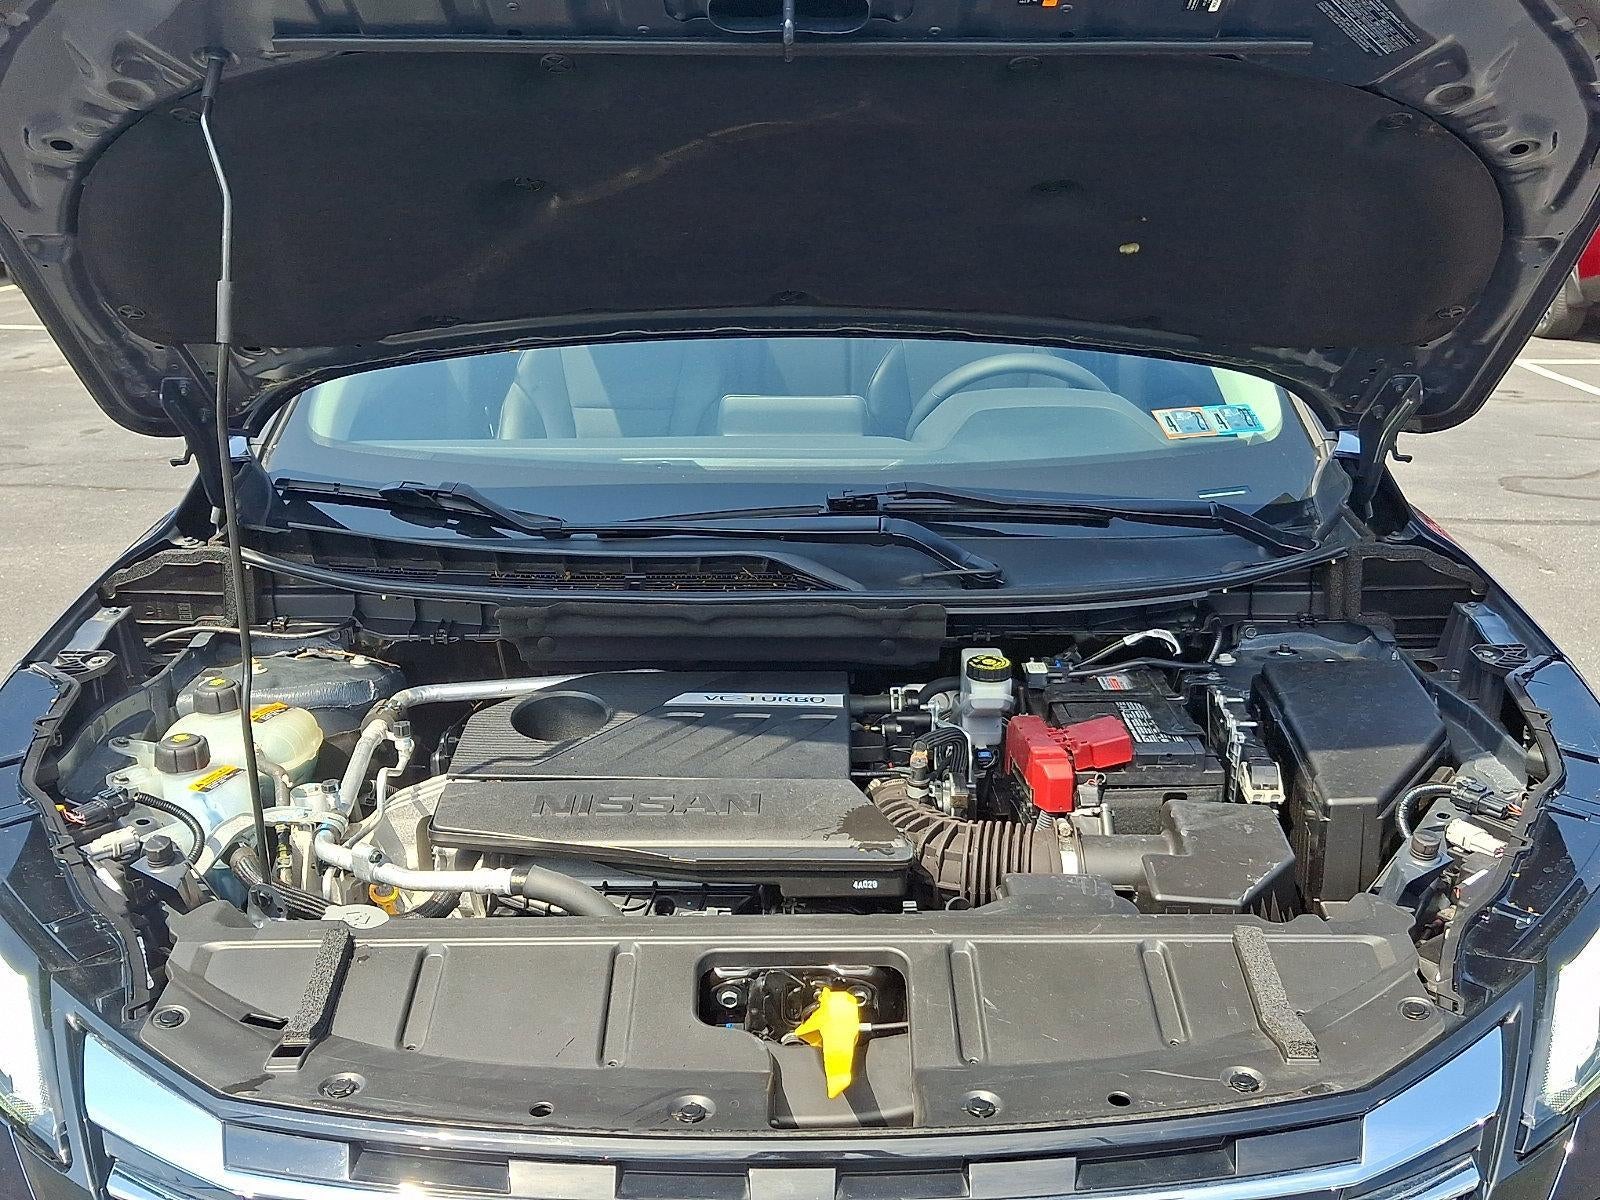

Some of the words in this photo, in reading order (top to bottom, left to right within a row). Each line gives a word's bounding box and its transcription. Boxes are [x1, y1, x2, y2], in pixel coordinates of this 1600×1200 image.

[1165, 415, 1179, 432] 4
[1214, 413, 1228, 429] 4
[704, 695, 826, 704] VC-TURBO
[531, 794, 762, 816] NISSAN
